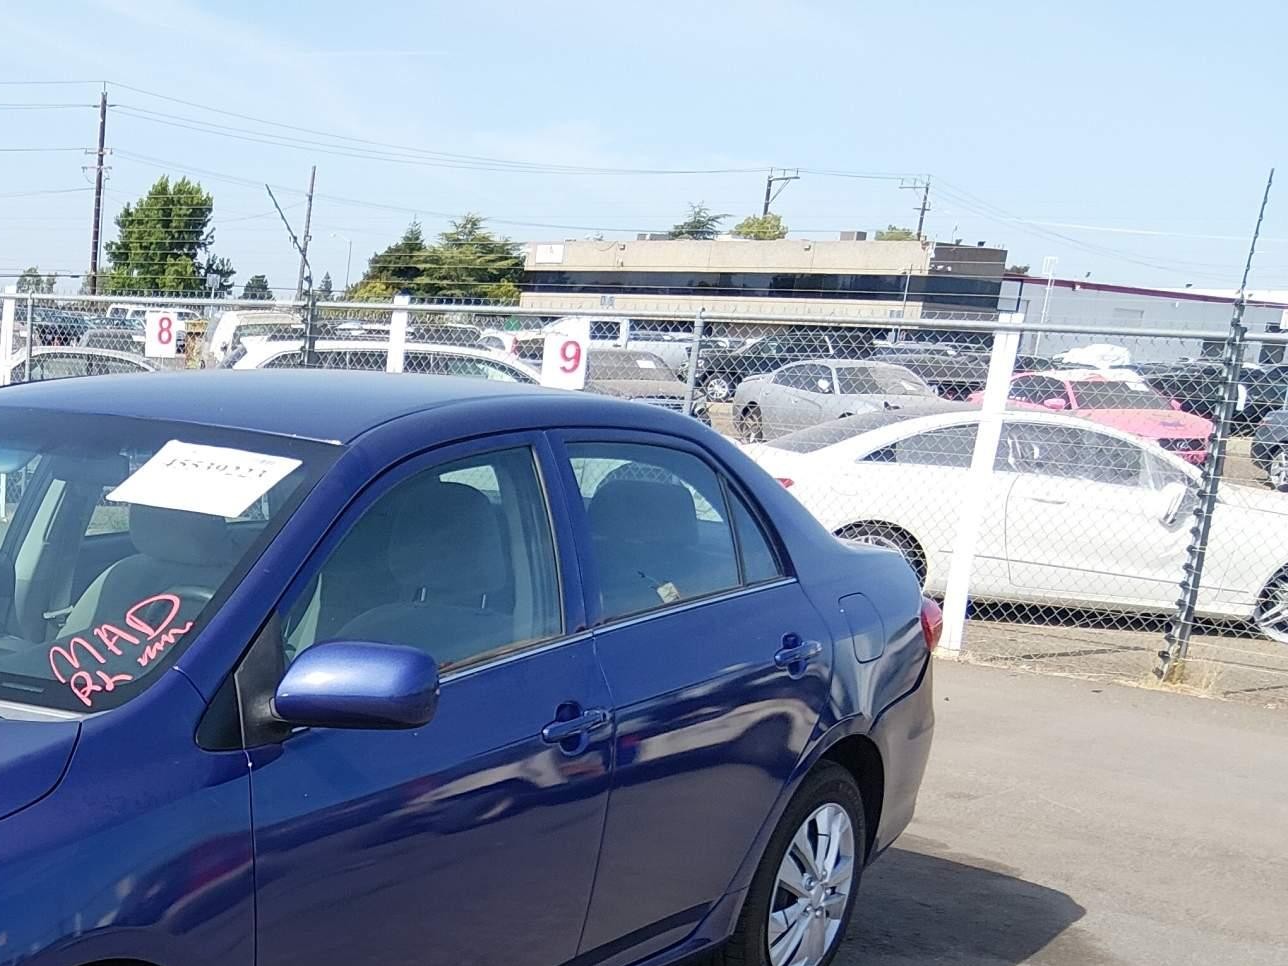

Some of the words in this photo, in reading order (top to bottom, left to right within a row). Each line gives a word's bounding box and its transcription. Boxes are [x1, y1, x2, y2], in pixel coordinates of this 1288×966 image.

[158, 317, 172, 345] 8
[560, 340, 581, 373] 9
[50, 594, 181, 684] MAD
